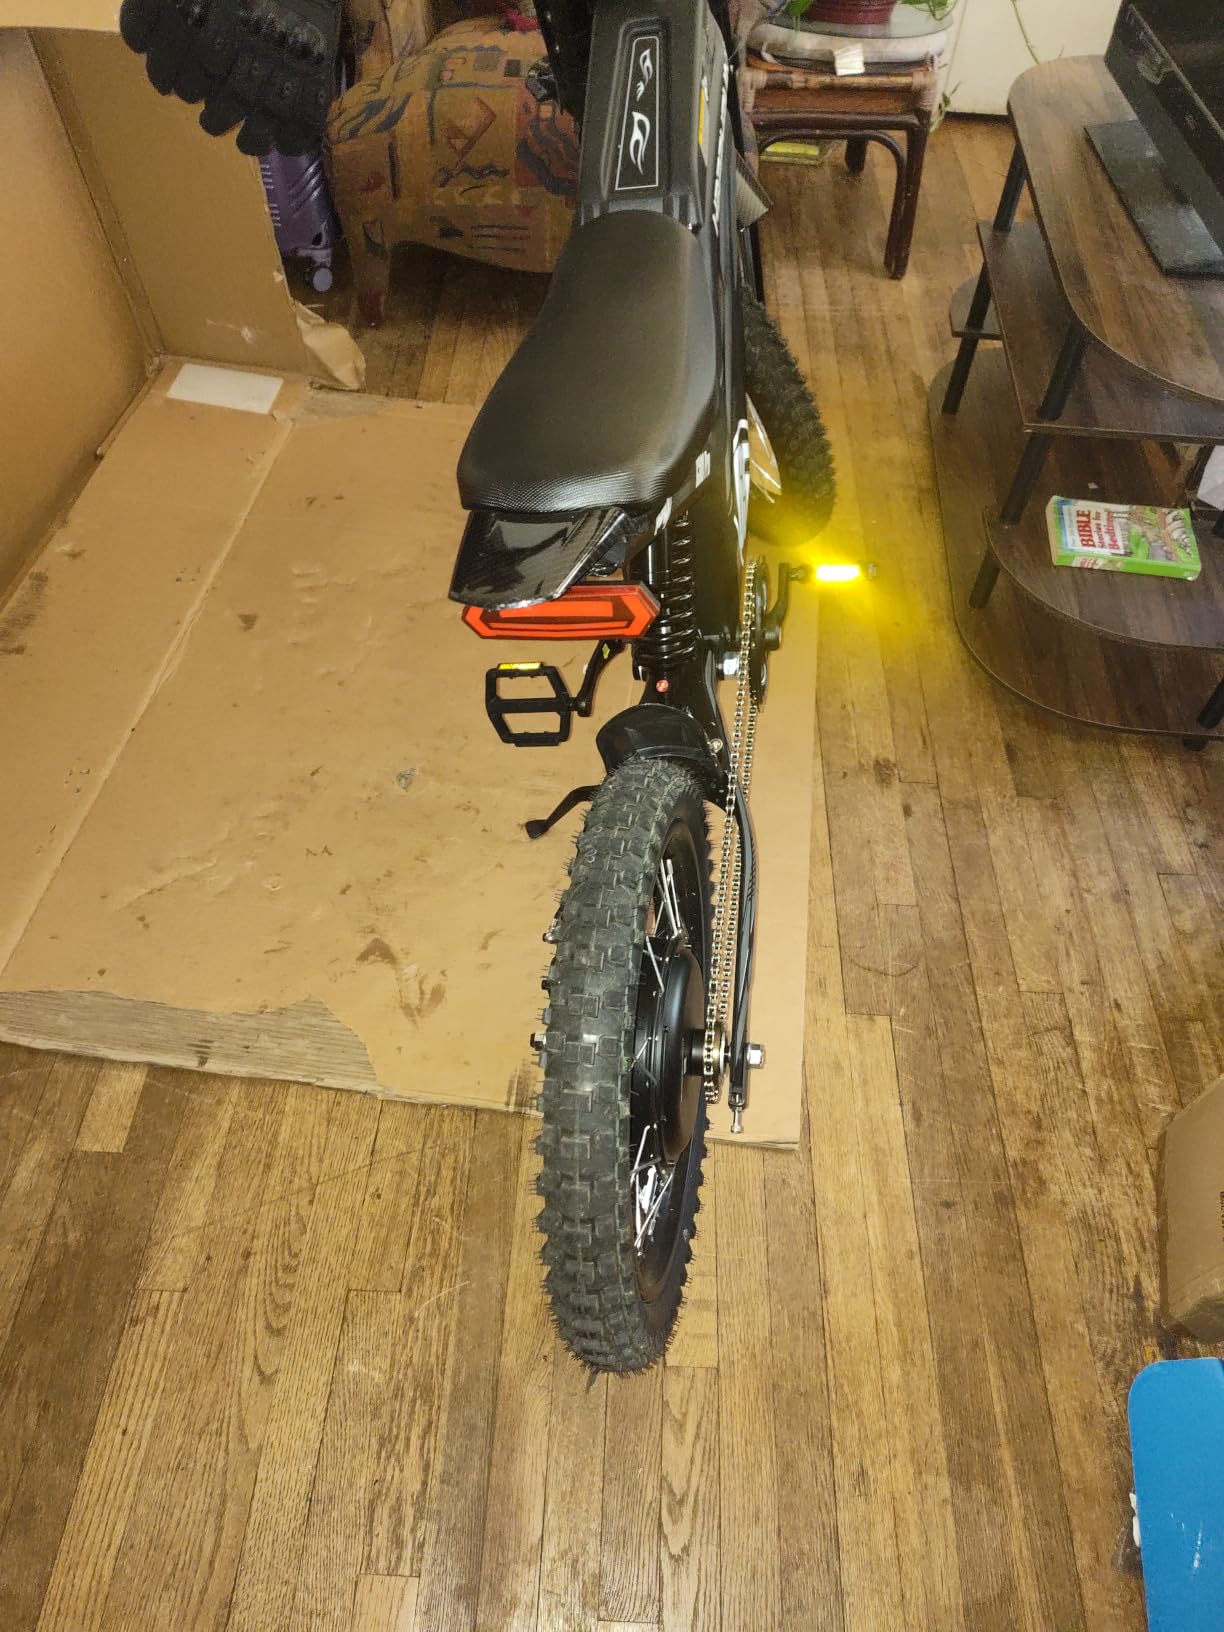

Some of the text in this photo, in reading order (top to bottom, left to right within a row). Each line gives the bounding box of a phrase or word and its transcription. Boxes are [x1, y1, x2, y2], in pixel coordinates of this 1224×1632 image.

[1076, 509, 1096, 548] BIBLE
[1094, 522, 1105, 549] Stories
[1104, 511, 1120, 550] Bedtime
